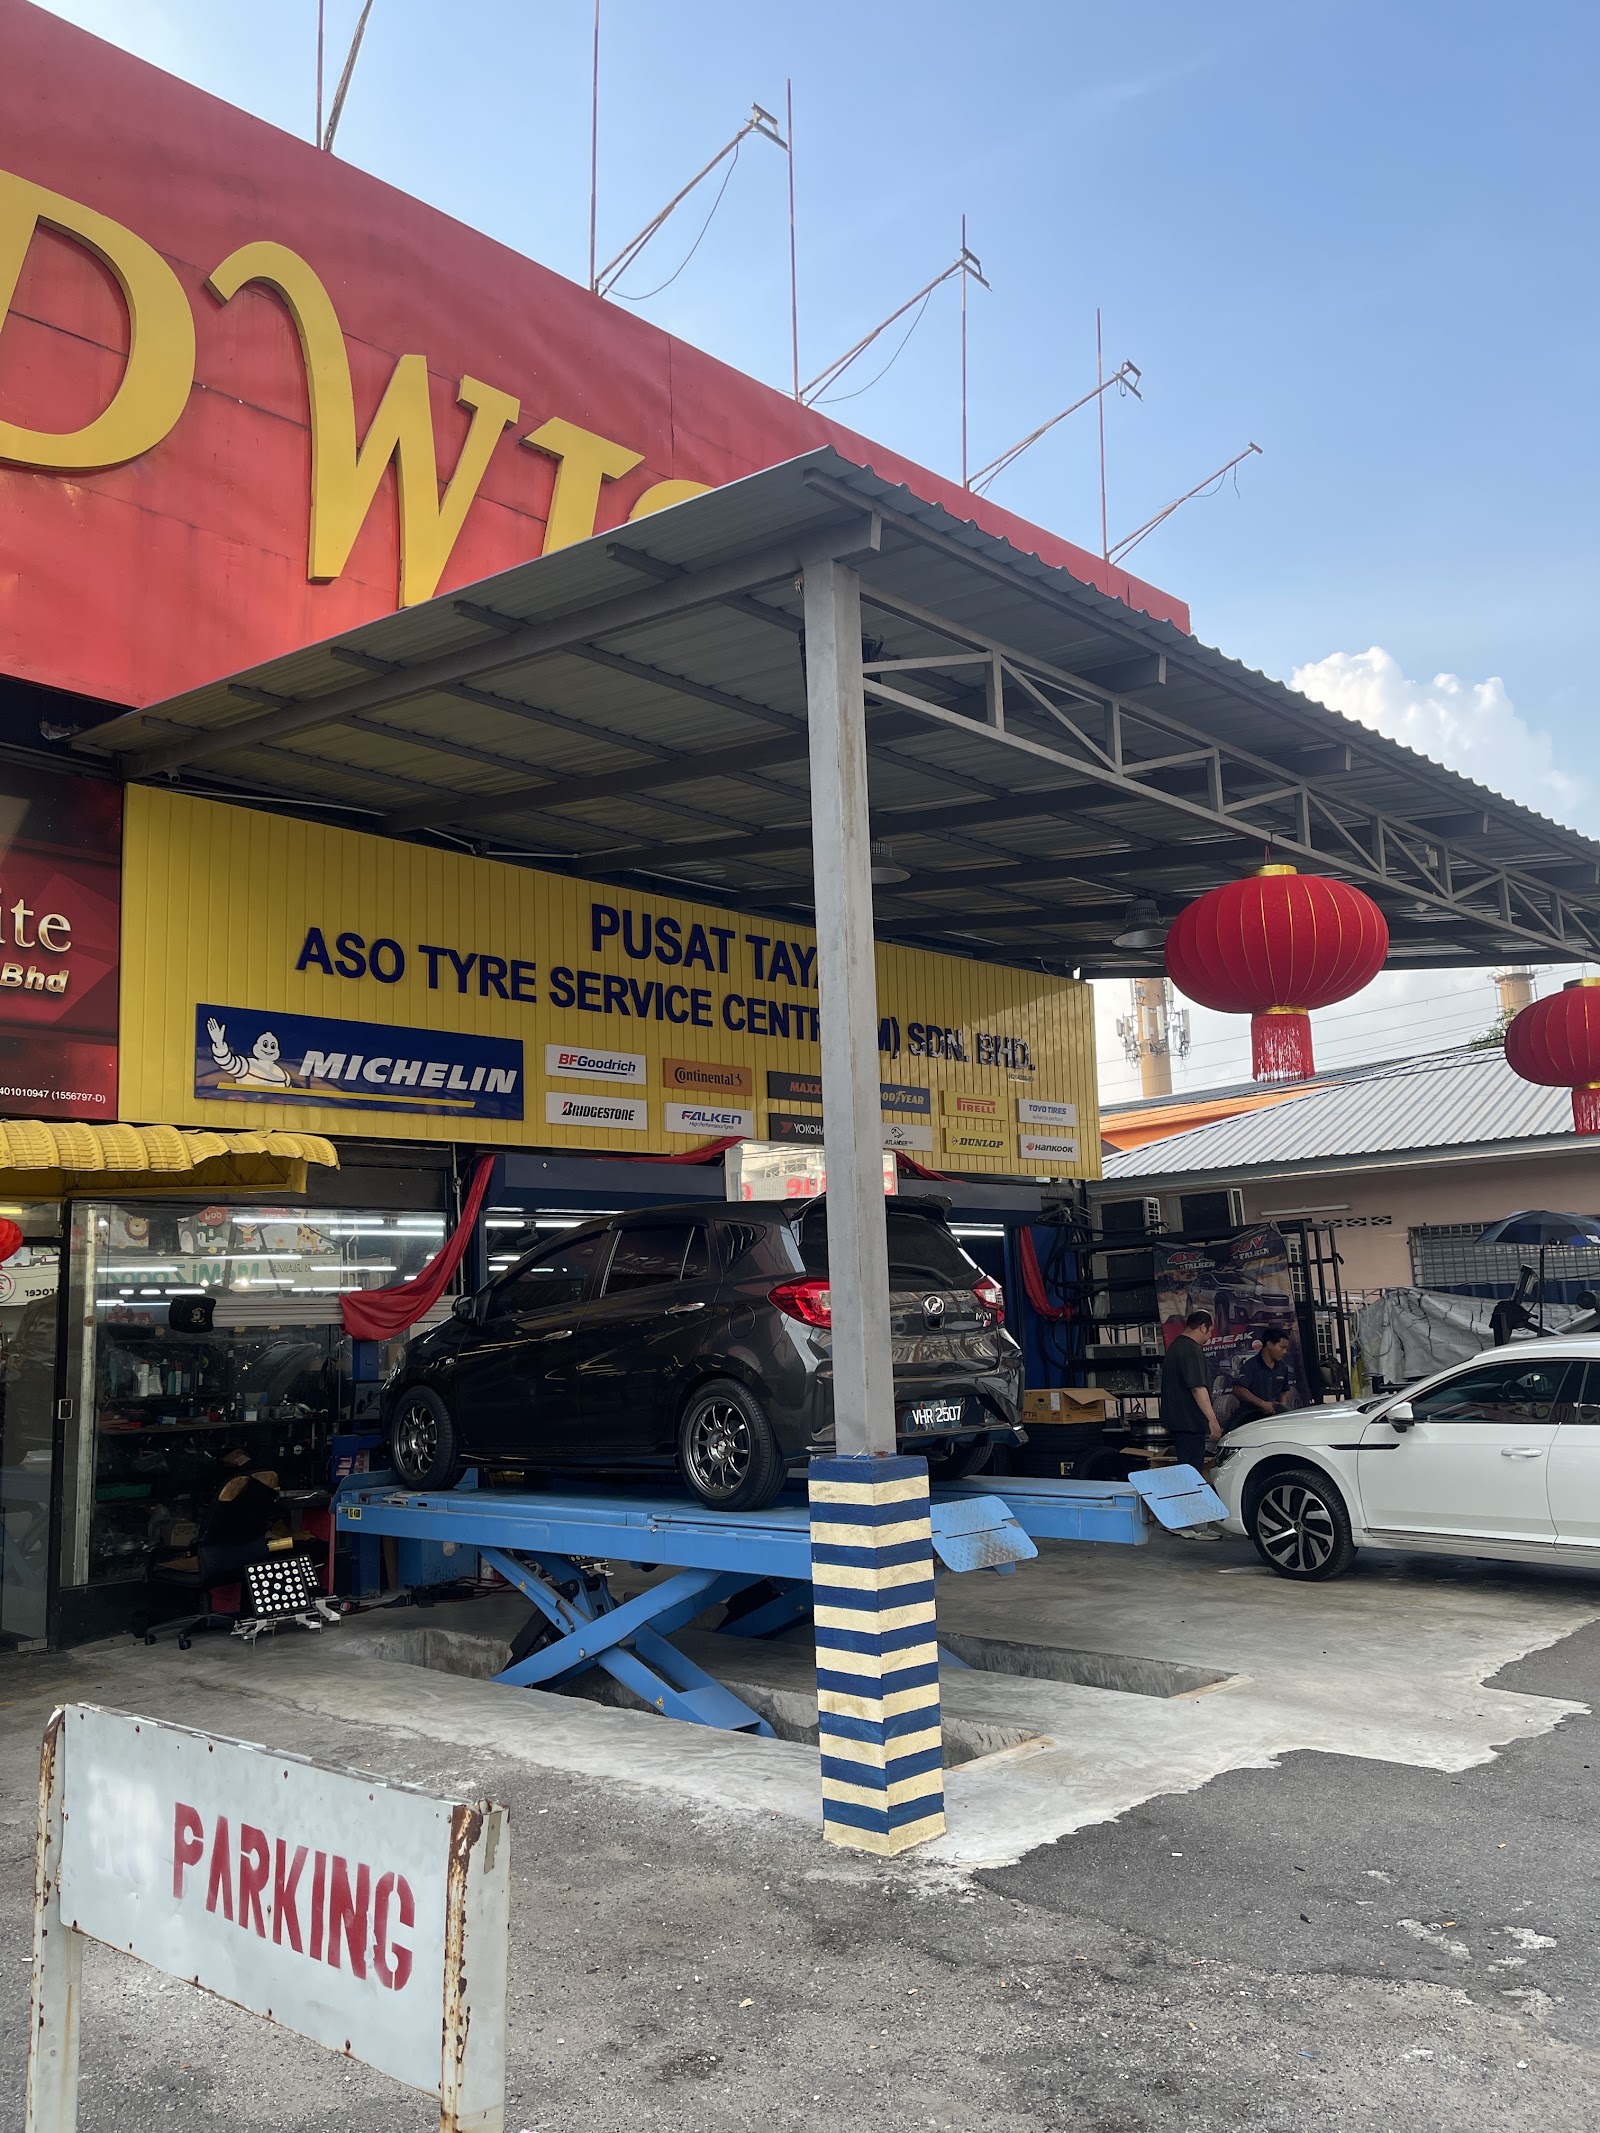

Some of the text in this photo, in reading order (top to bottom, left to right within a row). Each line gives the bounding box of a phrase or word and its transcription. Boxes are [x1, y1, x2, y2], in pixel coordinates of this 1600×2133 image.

[0, 888, 72, 952] te
[591, 903, 819, 989] PUSAT TAY
[0, 962, 69, 993] Bhd
[295, 927, 405, 984] ASO
[418, 944, 537, 1004] TYRE
[549, 966, 713, 1027] SERVICE
[299, 1050, 517, 1093] MICHELIN
[559, 1053, 636, 1072] BFGoodrich
[674, 1066, 734, 1086] Continental
[51, 1091, 106, 1104] (1556797-D)
[880, 1090, 924, 1105] ODYEAR
[957, 1098, 996, 1114] PIRELLI
[561, 1101, 635, 1121] BRIDGESTONE
[681, 1110, 742, 1124] FALKEN
[1029, 1104, 1067, 1115] TOYO TIRES
[959, 1137, 1004, 1149] DUNLOP
[912, 1405, 961, 1425] VHR 2507
[173, 1802, 416, 1991] PARKING
